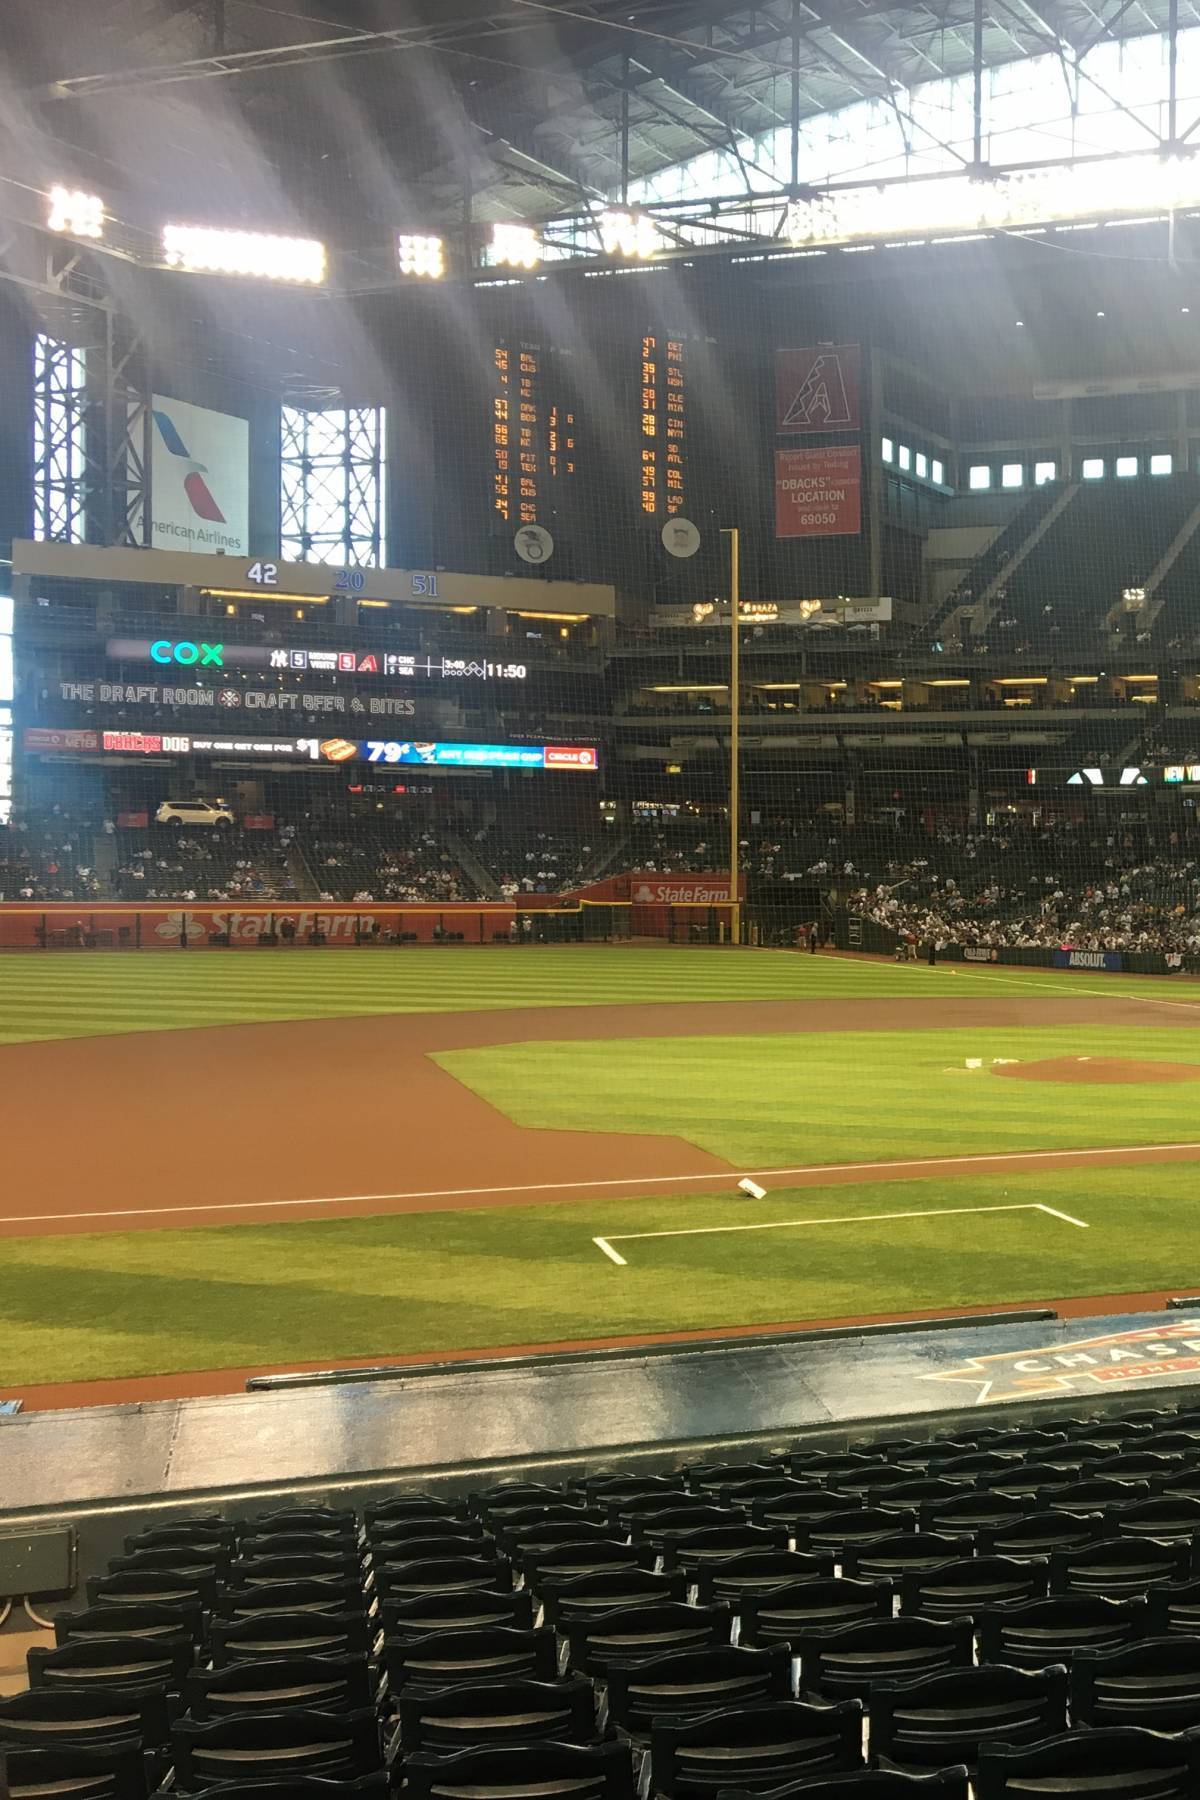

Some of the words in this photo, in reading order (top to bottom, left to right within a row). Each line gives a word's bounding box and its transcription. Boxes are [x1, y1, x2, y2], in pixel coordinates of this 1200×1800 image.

[642, 374, 656, 384] 31
[642, 399, 656, 410] 31
[667, 392, 684, 403] CLE
[642, 425, 656, 436] 48
[642, 450, 656, 461] 64
[791, 490, 846, 504] LOCATION
[800, 512, 836, 525] 69050
[196, 528, 241, 548] Airlines
[248, 562, 278, 584] 42
[335, 570, 366, 592] 20
[412, 575, 438, 596] 51
[150, 640, 224, 666] COX
[294, 652, 303, 666] 5
[342, 656, 352, 668] 5
[444, 660, 466, 670] 3:40
[398, 666, 414, 676] SEA
[487, 664, 526, 678] 11:50
[60, 683, 94, 700] THE
[100, 685, 158, 704] DRAFT
[163, 688, 214, 706] ROOM
[245, 692, 298, 710] CRAFT
[302, 694, 345, 712] BEER
[350, 698, 366, 713] &
[370, 698, 415, 715] BITES
[162, 736, 189, 752] DOG
[192, 741, 212, 749] BUY
[296, 738, 319, 760] $1
[1164, 766, 1184, 782] NEW
[656, 886, 693, 902] State
[694, 886, 728, 902] Farm
[209, 912, 295, 938] State
[296, 912, 375, 936] Farm
[1110, 1364, 1176, 1378] HOME
